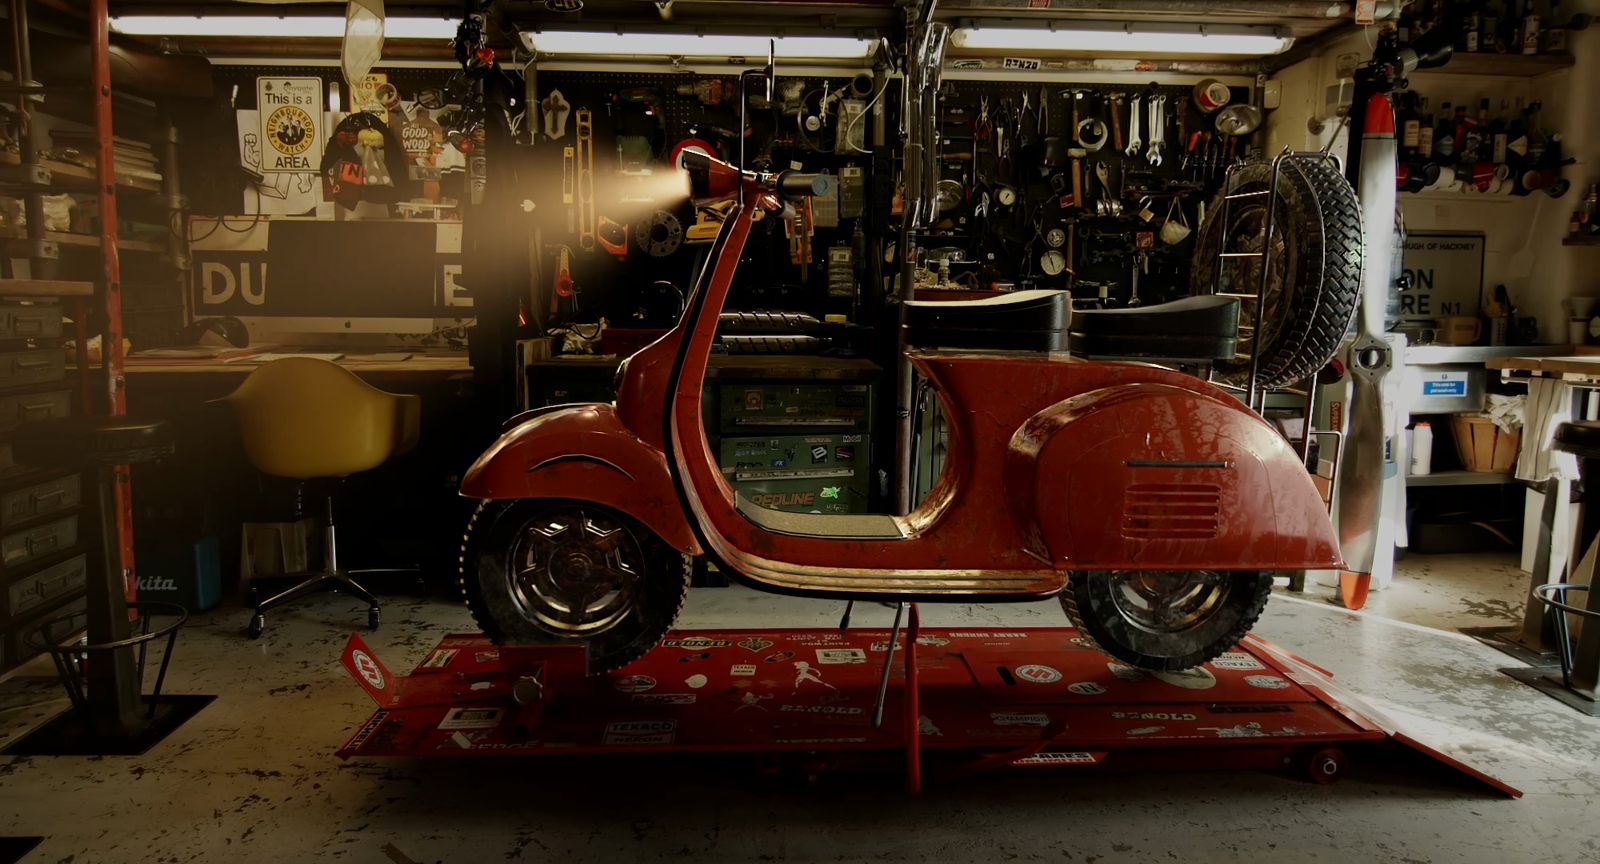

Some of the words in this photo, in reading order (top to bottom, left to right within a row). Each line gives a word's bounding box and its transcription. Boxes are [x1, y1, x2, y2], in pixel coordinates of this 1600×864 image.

[265, 93, 289, 104] This
[293, 93, 302, 104] is
[306, 96, 312, 104] a
[269, 108, 313, 138] NEIGHBOURHOOD
[402, 127, 428, 139] GOOD
[278, 144, 306, 153] WATCH
[402, 139, 431, 150] WOOD
[275, 156, 310, 168] AREA
[613, 723, 672, 731] TEXACO
